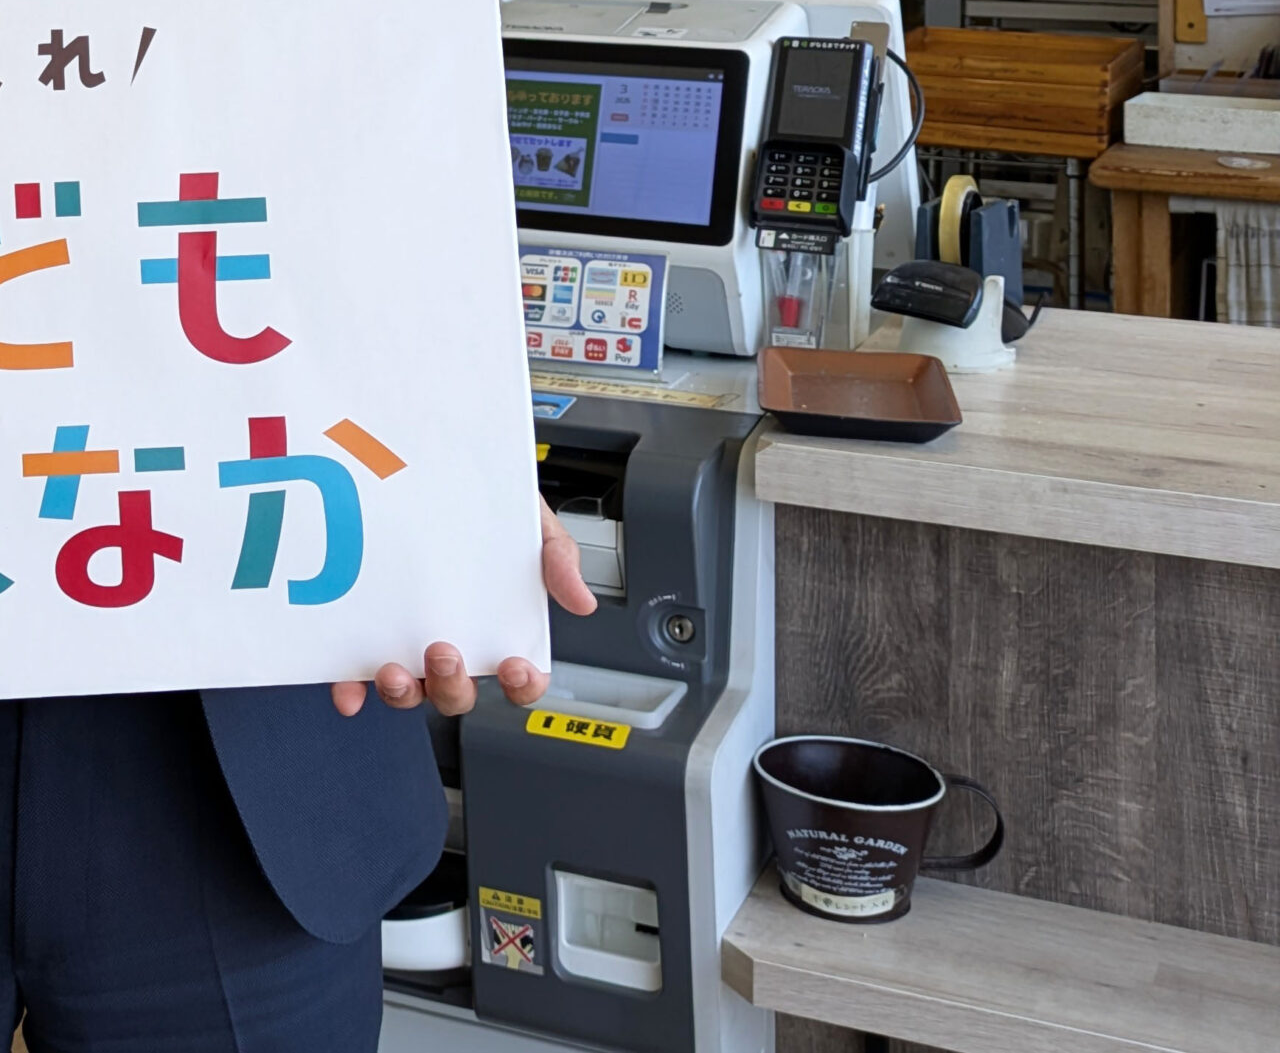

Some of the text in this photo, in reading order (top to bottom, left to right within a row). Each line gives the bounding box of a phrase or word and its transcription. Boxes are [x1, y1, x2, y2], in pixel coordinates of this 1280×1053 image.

[619, 84, 628, 94] 3
[525, 267, 545, 276] VISA
[625, 302, 640, 311] Edy
[615, 353, 632, 364] Pay
[566, 719, 618, 741] 硬貨
[786, 829, 908, 856] NATURAL GARDEN
